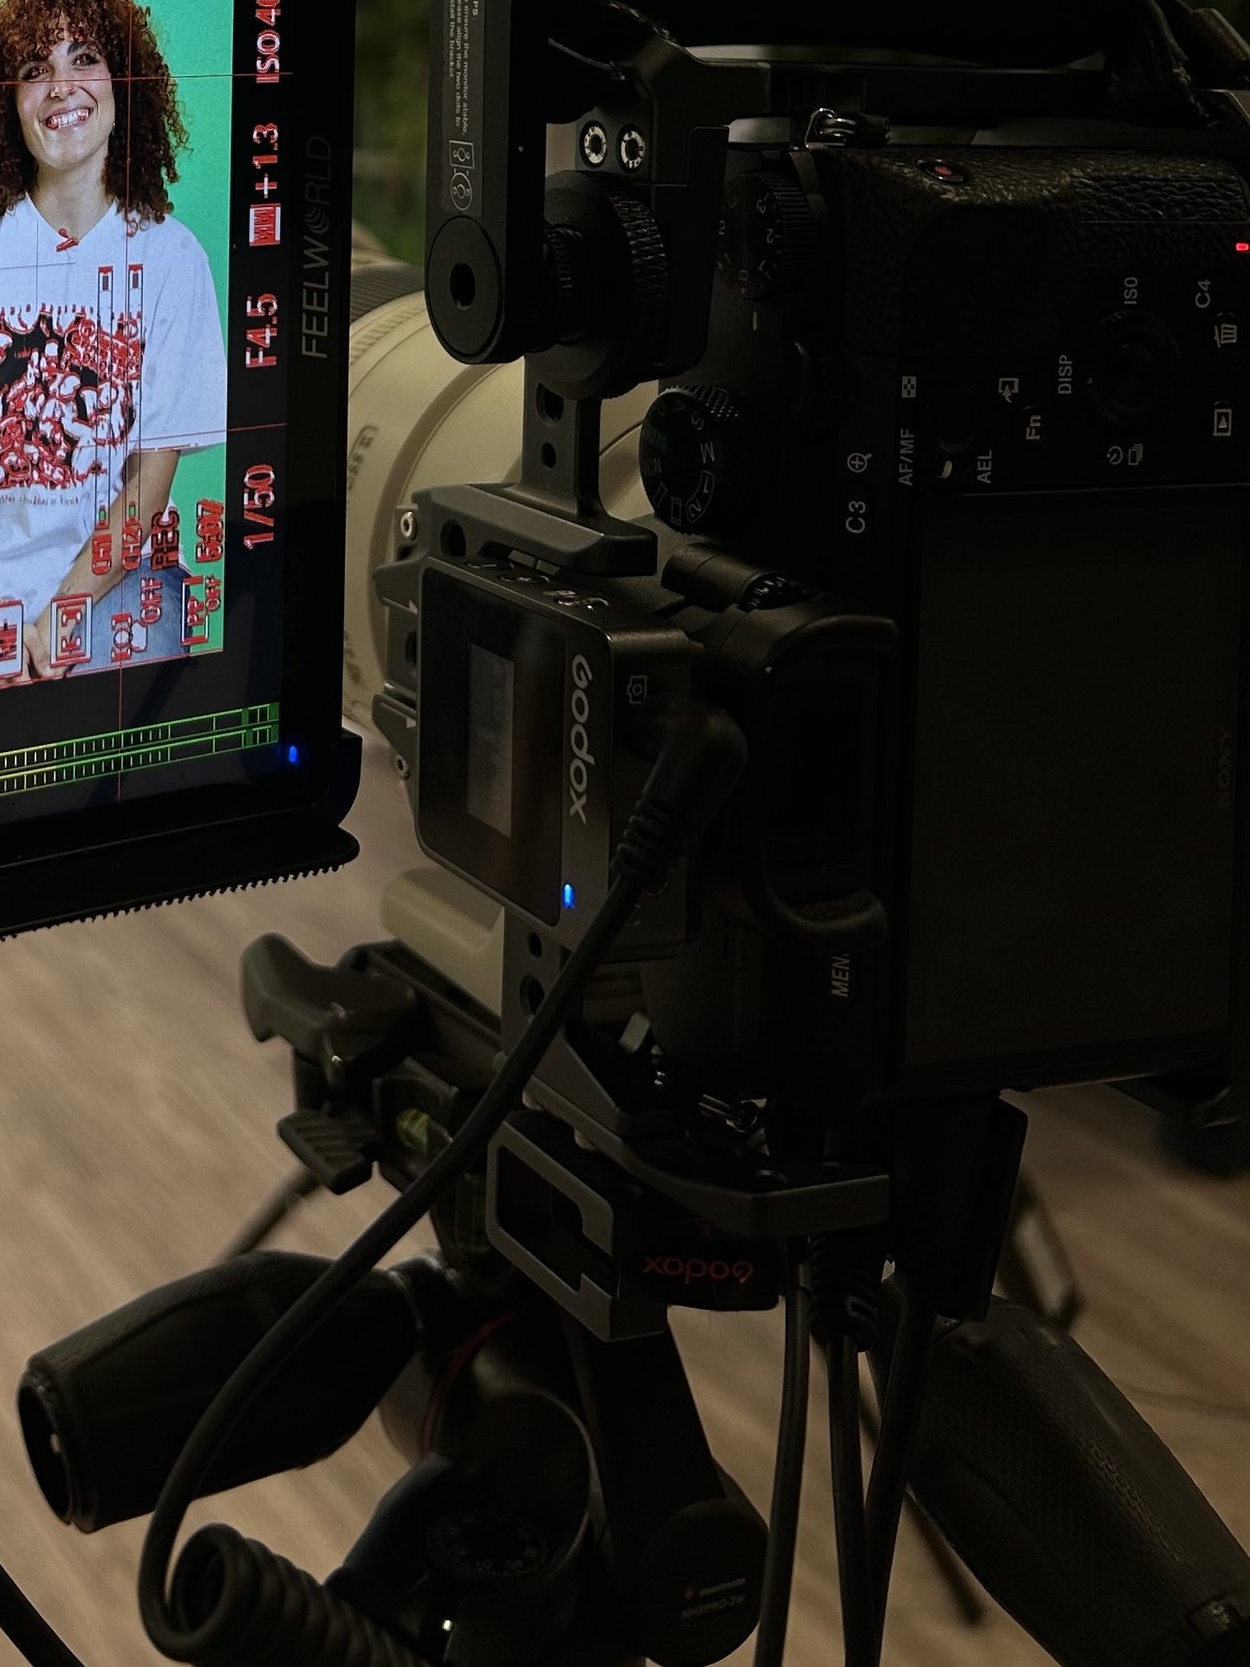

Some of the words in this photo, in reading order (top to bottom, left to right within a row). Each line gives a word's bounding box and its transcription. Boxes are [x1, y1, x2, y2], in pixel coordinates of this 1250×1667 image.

[254, 30, 284, 84] ISO
[250, 121, 281, 200] +1.3
[299, 135, 333, 360] FEELWORLD
[1123, 276, 1138, 306] ISO
[1195, 278, 1211, 309] C4
[243, 292, 281, 370] F4.5
[1057, 354, 1073, 395] DISP
[1025, 413, 1041, 440] Fn
[898, 427, 914, 486] AF/MF
[976, 449, 992, 485] AEL
[241, 462, 280, 553] 1/50
[845, 500, 866, 534] C3
[149, 508, 180, 571] REC
[140, 576, 163, 624] OFF
[204, 574, 222, 612] OFF
[569, 653, 596, 826] Godox
[1217, 726, 1231, 808] SONY
[830, 952, 851, 998] MEN
[639, 1255, 755, 1285] Godox
